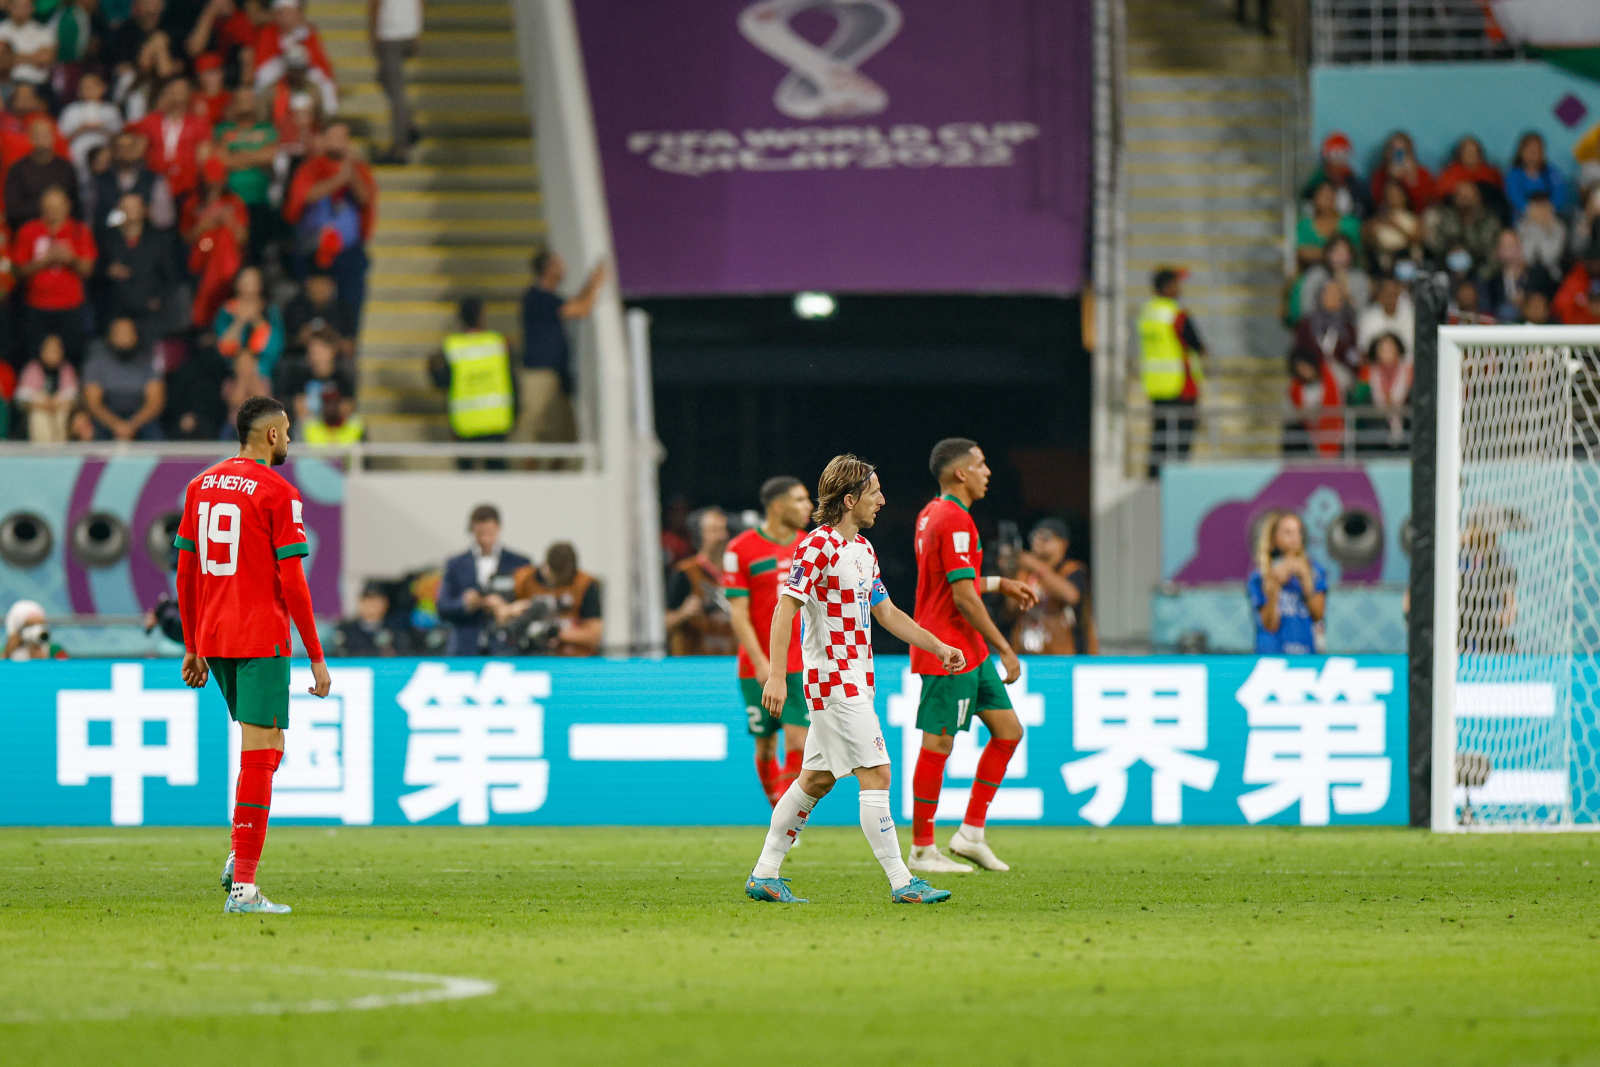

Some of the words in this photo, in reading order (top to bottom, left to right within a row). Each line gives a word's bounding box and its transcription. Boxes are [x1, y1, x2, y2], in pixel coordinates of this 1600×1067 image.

[627, 128, 739, 155] FIFA
[743, 125, 932, 152] WORLD
[937, 122, 1039, 150] CUP
[201, 474, 258, 496] EN-NESYRI
[197, 501, 242, 577] 19
[745, 705, 765, 733] 2
[56, 662, 728, 827] 中国第一
